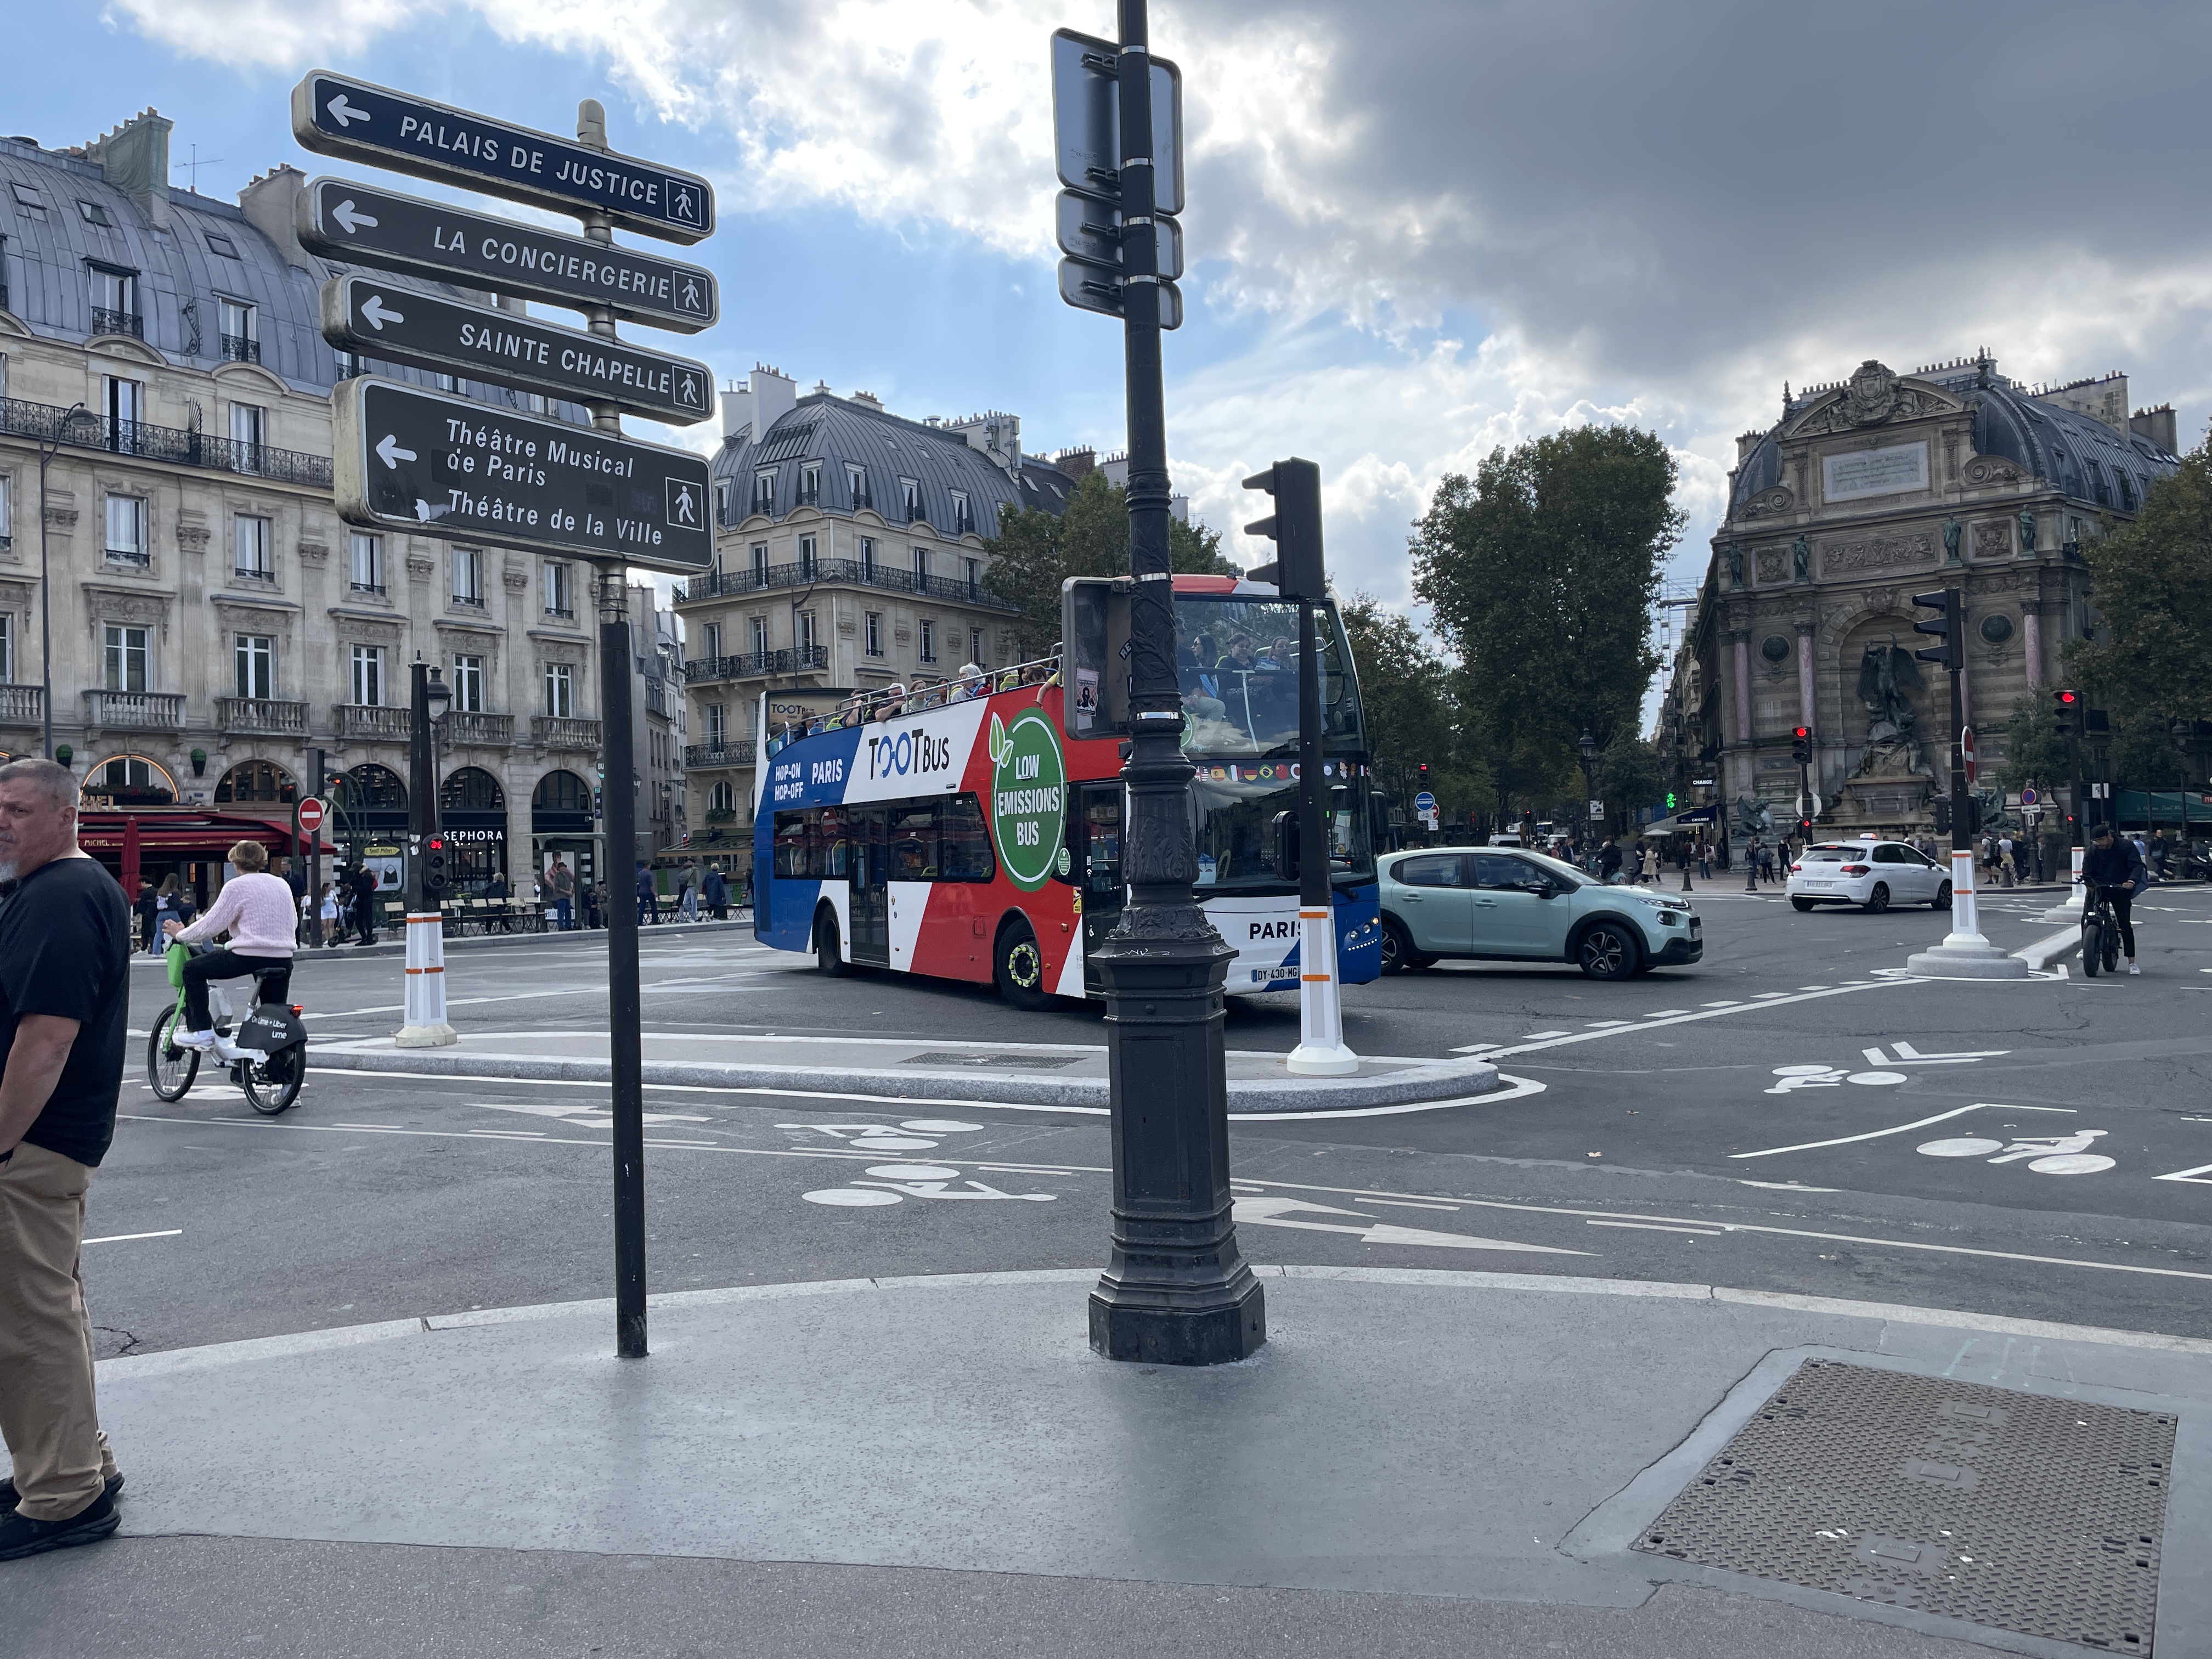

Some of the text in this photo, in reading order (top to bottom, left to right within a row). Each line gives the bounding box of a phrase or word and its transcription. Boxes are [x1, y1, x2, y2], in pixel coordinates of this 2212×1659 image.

[400, 116, 658, 205] PALAIS DE JUSTICE
[434, 226, 669, 300] LA CONCIERGERIE
[459, 324, 670, 394] SAINTE CHAPELLE
[446, 417, 633, 478] Théâtre Musical
[447, 448, 546, 487] de Paris
[448, 489, 662, 546] Théâtre de la Ville
[771, 704, 814, 715] TOOTB
[775, 761, 802, 782] HOP-ON
[811, 758, 843, 785] PARIS
[1015, 754, 1040, 780] LOW
[81, 794, 118, 811] HEL
[774, 781, 804, 801] HOP-OFF
[997, 786, 1060, 817] EMISSIONS
[443, 831, 503, 841] SEPHORA
[1017, 821, 1039, 846] BUS
[272, 1030, 287, 1039] Lime
[273, 1020, 287, 1029] Uber
